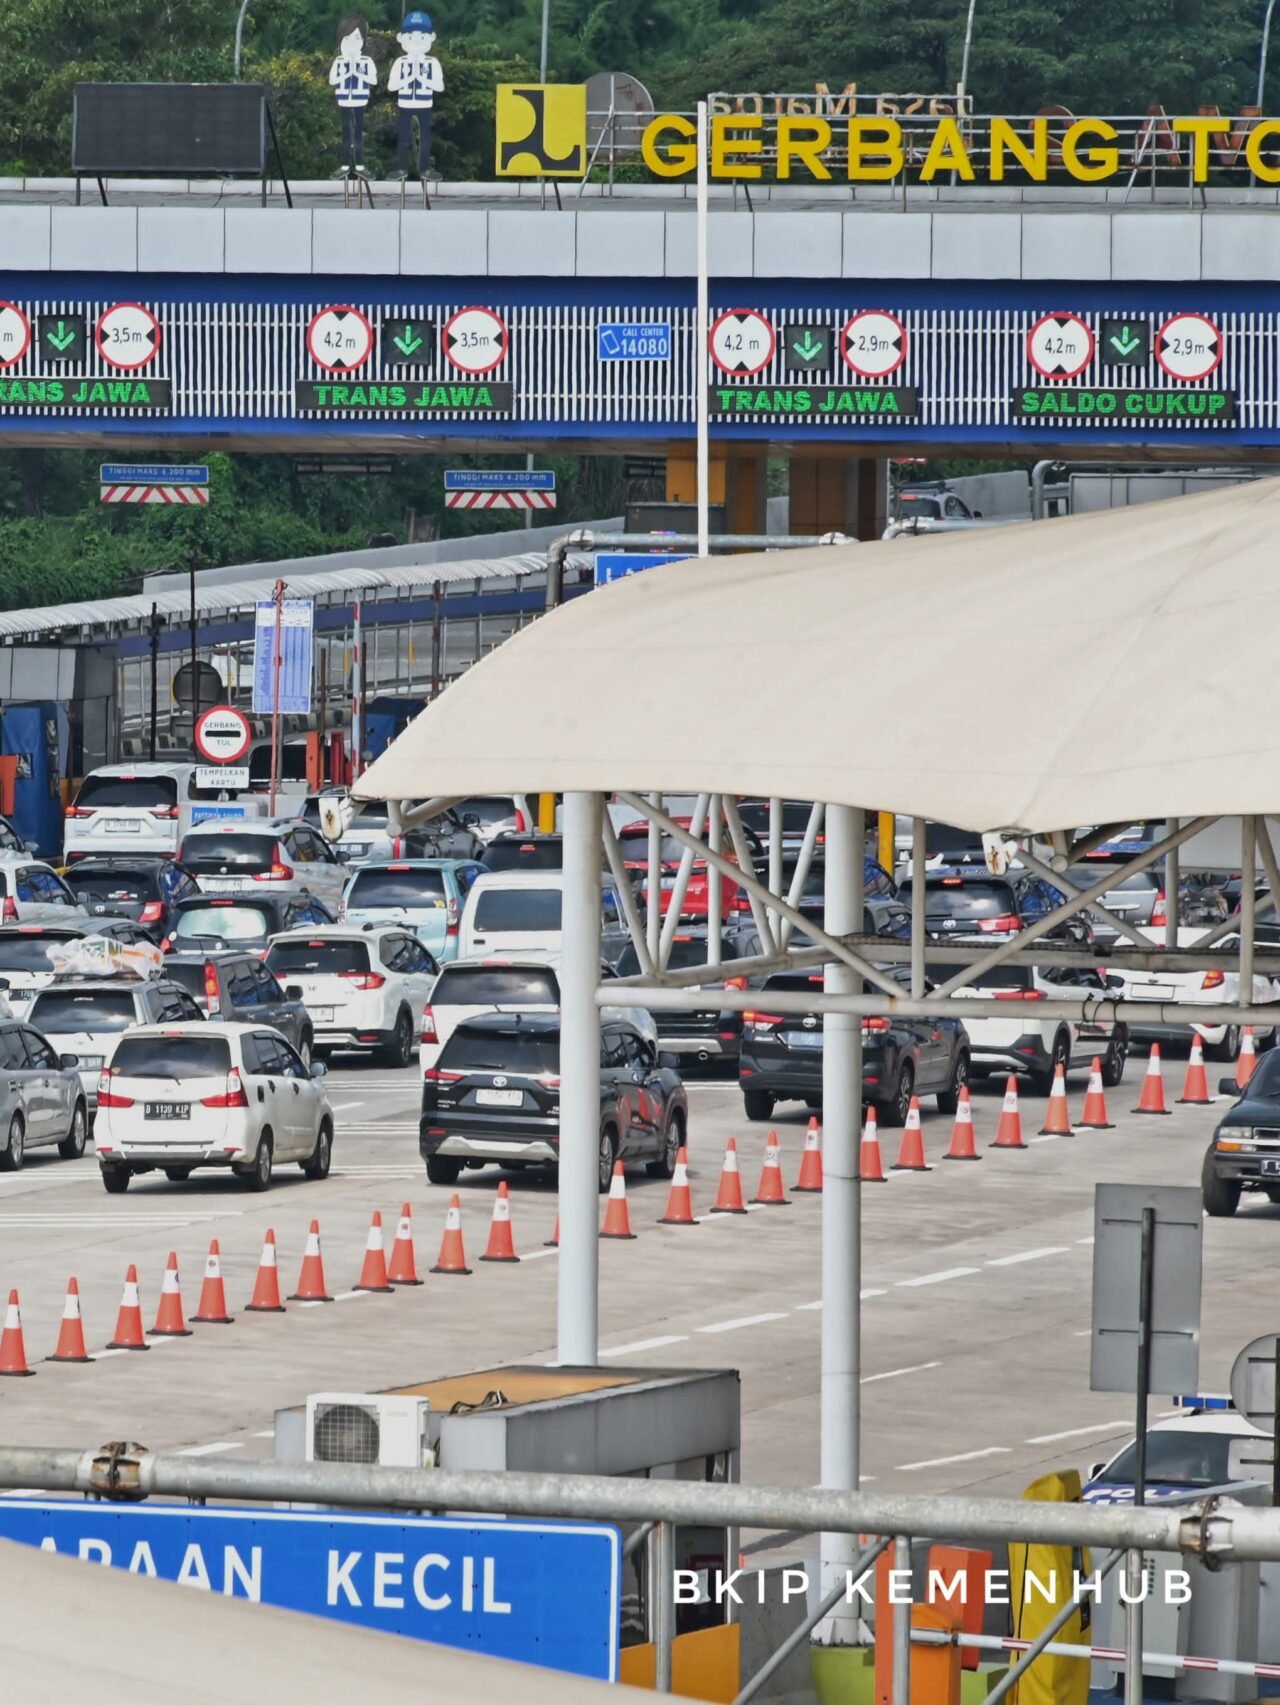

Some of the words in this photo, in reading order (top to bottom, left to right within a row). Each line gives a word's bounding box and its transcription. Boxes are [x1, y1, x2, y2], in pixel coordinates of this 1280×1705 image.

[641, 114, 1120, 182] GERBANG
[324, 331, 343, 349] 4,2
[621, 338, 668, 356] 14080
[724, 334, 743, 352] 4,2
[1044, 337, 1064, 355] 4,2
[72, 381, 152, 404] JAWA
[312, 385, 408, 407] TRANS
[414, 386, 493, 407] JAWA
[717, 389, 812, 412] TRANS
[819, 391, 900, 413] JAWA
[1022, 391, 1117, 414] SALDO
[1124, 393, 1226, 415] CUKUP
[326, 1549, 513, 1614] KECIL
